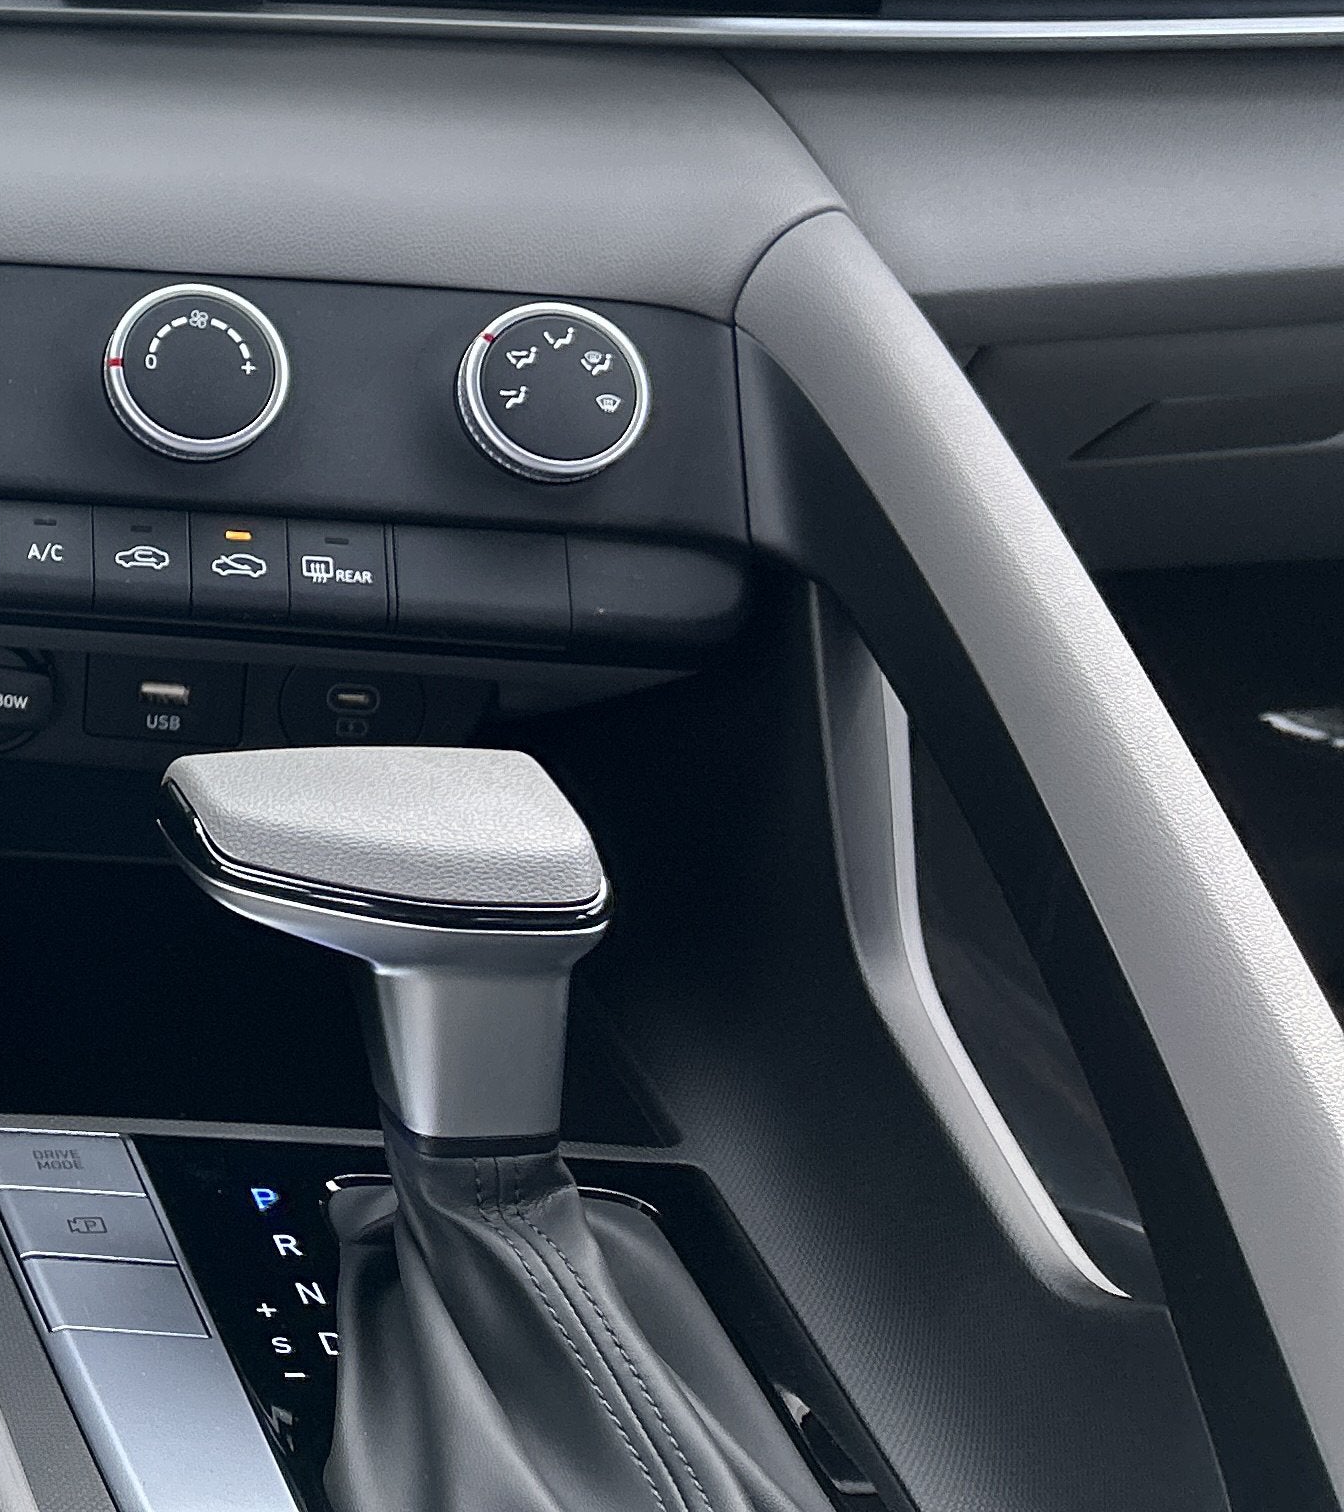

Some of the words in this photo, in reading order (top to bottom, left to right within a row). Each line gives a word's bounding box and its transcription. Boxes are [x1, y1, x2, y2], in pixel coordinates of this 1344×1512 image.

[27, 541, 64, 565] A/C
[335, 569, 373, 584] REAR
[146, 713, 181, 731] USB
[32, 1149, 81, 1160] DRIVE
[36, 1159, 85, 1170] MODE
[250, 1187, 280, 1210] P
[272, 1234, 303, 1256] R
[294, 1281, 327, 1305] N
[271, 1336, 292, 1354] S
